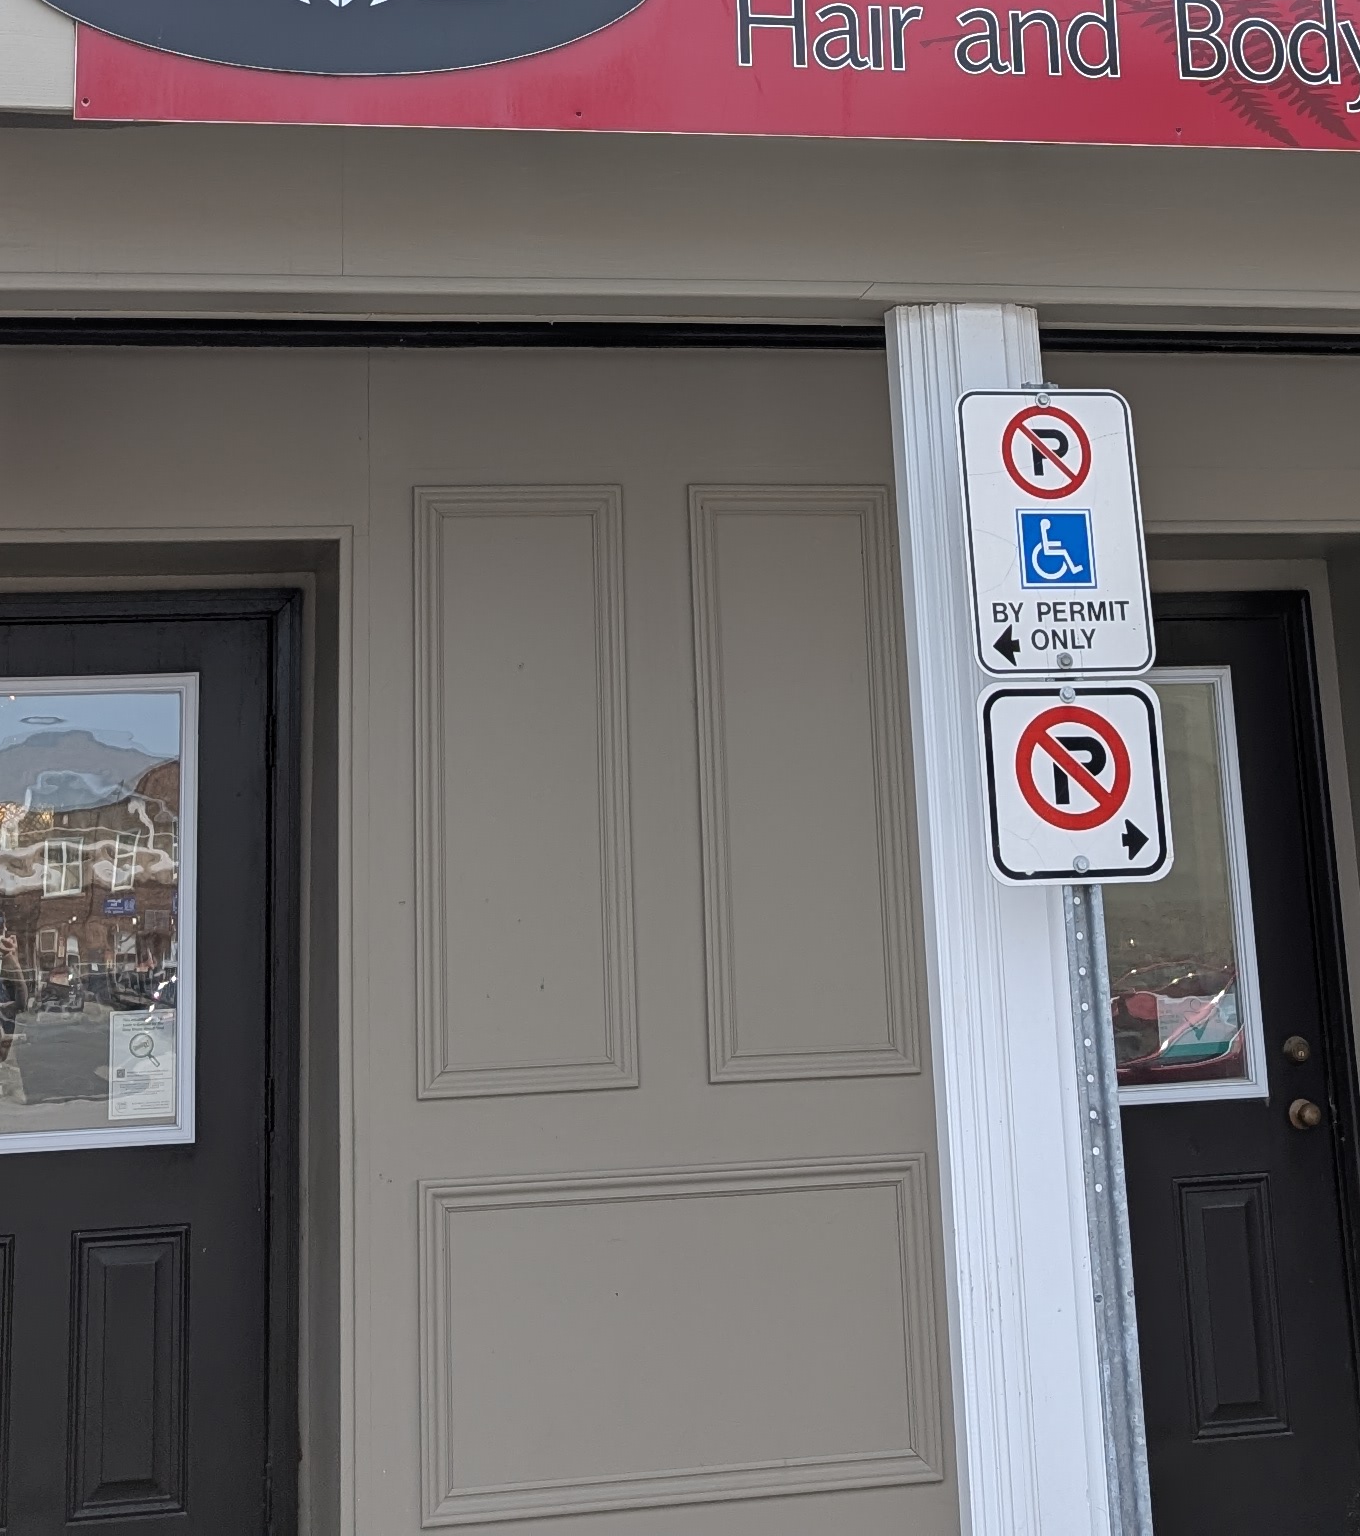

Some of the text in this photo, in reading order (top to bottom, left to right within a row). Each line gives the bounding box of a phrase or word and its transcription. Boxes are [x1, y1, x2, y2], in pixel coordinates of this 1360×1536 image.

[991, 600, 1130, 623] BY PERMIT
[1031, 628, 1096, 651] ONLY
